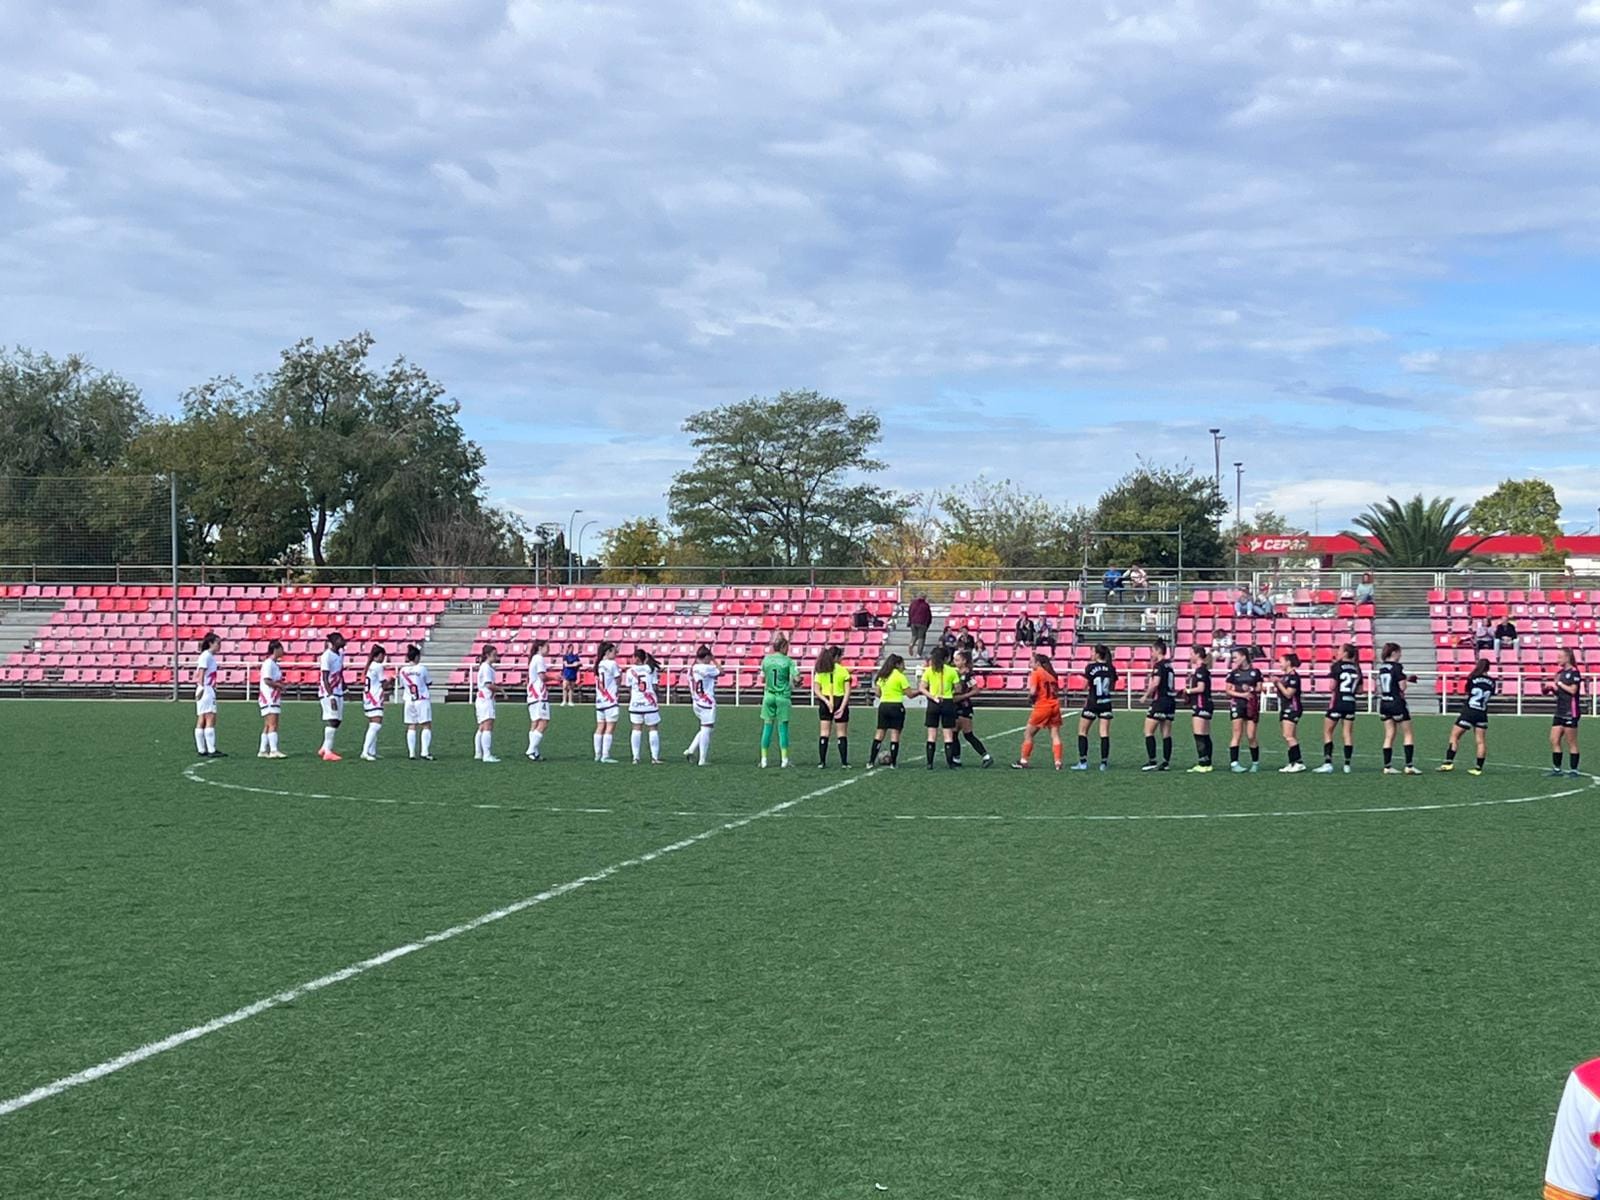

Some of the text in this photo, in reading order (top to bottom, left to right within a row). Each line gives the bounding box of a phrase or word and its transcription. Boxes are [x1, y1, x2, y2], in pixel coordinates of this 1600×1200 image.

[637, 675, 647, 692] 5
[1093, 676, 1110, 696] 14
[1339, 672, 1359, 693] 27
[409, 684, 419, 701] 9
